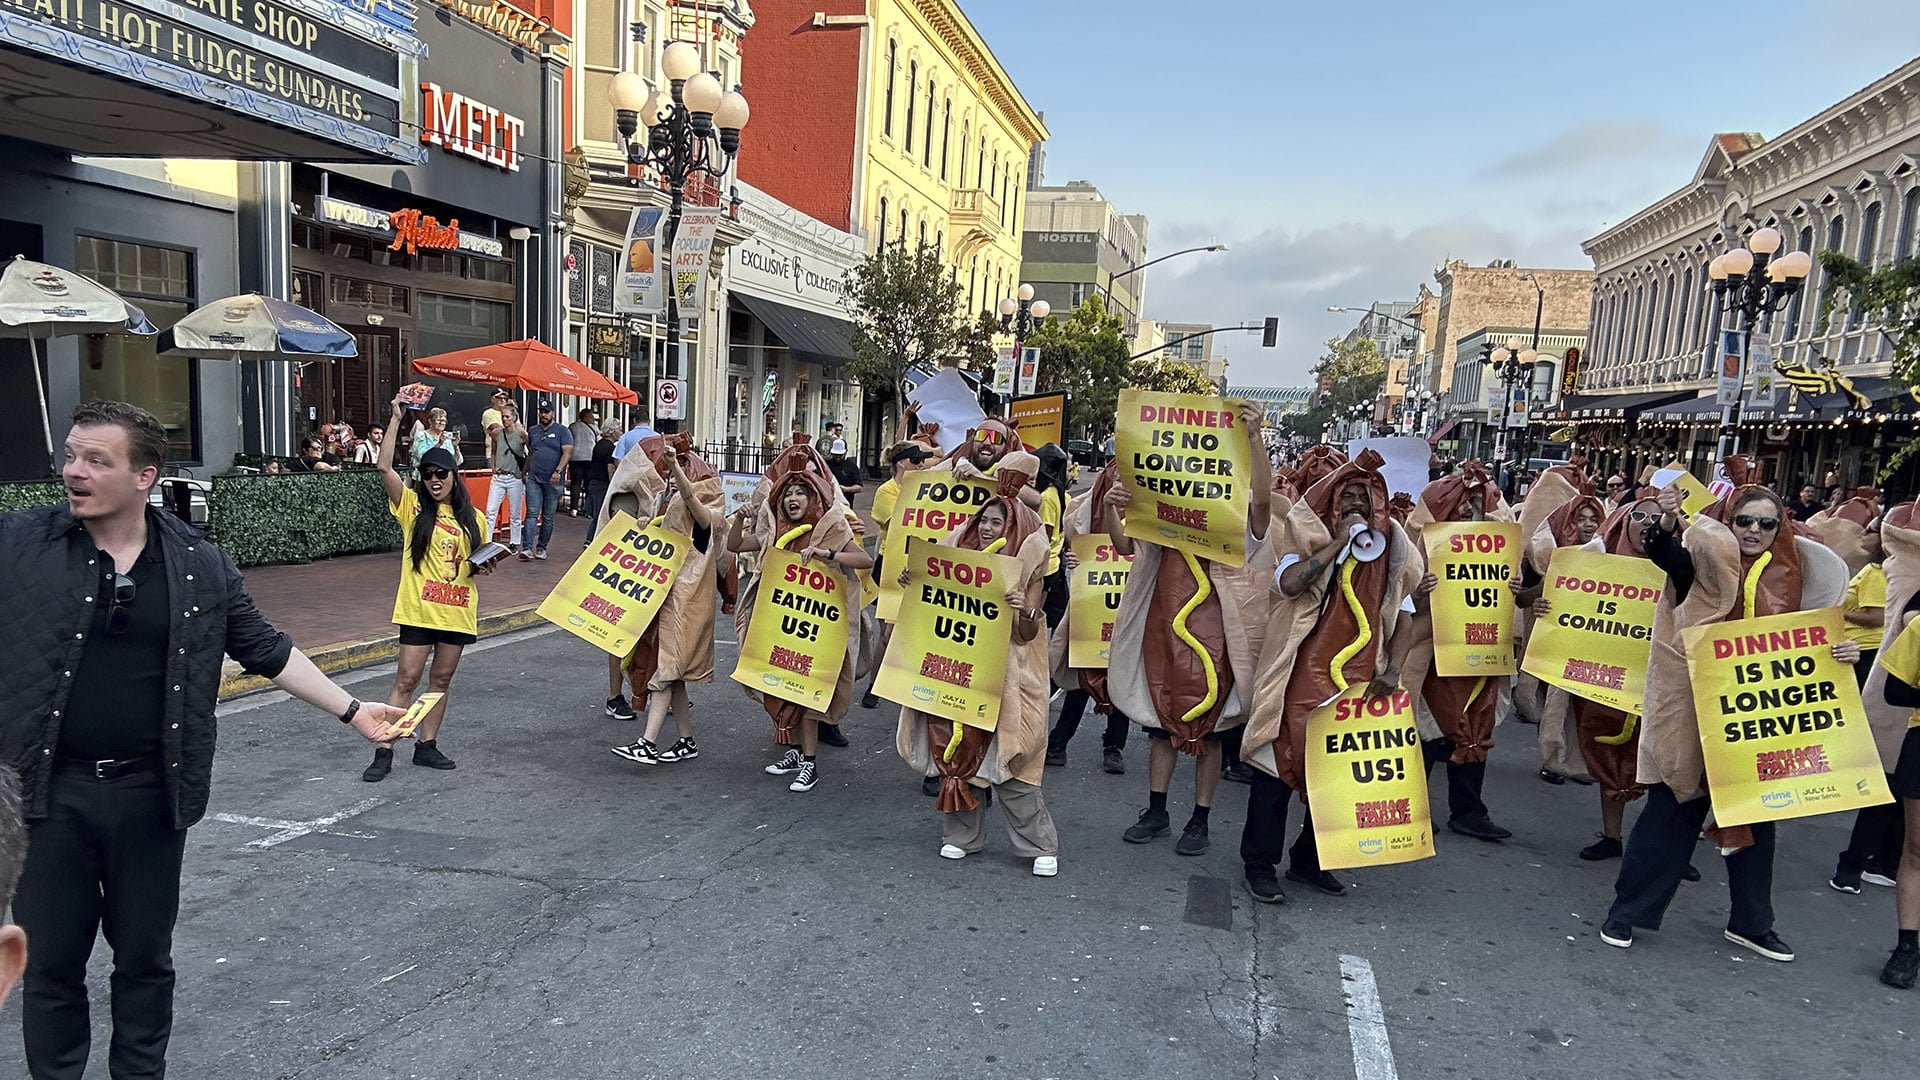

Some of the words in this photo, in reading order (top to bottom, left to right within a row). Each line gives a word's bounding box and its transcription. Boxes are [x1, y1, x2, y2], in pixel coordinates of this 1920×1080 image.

[186, 0, 244, 24] TE
[253, 2, 318, 50] SHOP
[3, 0, 84, 30] AT!
[100, 3, 161, 54] HOT
[172, 27, 257, 88] FUDGE
[264, 62, 363, 121] SUNDAES
[421, 82, 524, 172] MELT
[322, 199, 391, 232] WORLD'S
[459, 232, 503, 257] BURGER
[681, 215, 717, 224] CELEBRATING
[689, 226, 703, 236] THE
[675, 238, 710, 251] POPULAR
[1038, 233, 1091, 243] HOSTEL
[676, 253, 703, 266] ARTS
[741, 249, 789, 279] EXCLUSIVE
[684, 272, 698, 283] CON
[1140, 405, 1234, 428] DINNER
[1152, 430, 1175, 447] IS
[1181, 432, 1219, 451] NO
[1133, 453, 1233, 476] LONGER
[917, 483, 991, 506] FOOD
[1135, 475, 1232, 500] SERVED!
[902, 508, 973, 531] FIGH
[621, 529, 675, 560] FOOD
[1095, 545, 1134, 562] ST
[1450, 534, 1506, 553] STOP
[599, 542, 671, 585] FIGHTS
[927, 556, 992, 588] STOP
[1445, 564, 1510, 581] EATING
[589, 563, 655, 604] BACK!
[784, 564, 836, 594] STOP
[1088, 571, 1129, 585] EATI
[1555, 576, 1661, 603] FOODTOPI
[771, 588, 840, 622] EATING
[921, 584, 999, 620] EATING
[1105, 593, 1121, 609] U
[1465, 588, 1498, 608] US!
[1597, 600, 1617, 615] IS
[781, 615, 819, 642] US!
[934, 616, 977, 646] US!
[1558, 613, 1653, 641] COMING!
[1713, 626, 1829, 659] DINNER
[1735, 662, 1763, 684] IS
[1770, 656, 1816, 679] NO
[913, 685, 935, 697] prime
[942, 694, 959, 702] JULY
[1720, 681, 1838, 715] LONGER
[1335, 691, 1411, 721] STOP
[1725, 708, 1845, 742] SERVED!
[1326, 726, 1417, 754] EATING
[1351, 757, 1405, 783] US!
[1761, 790, 1792, 803] prime
[1803, 787, 1826, 795] JULY
[1822, 793, 1842, 801] Series
[1358, 838, 1382, 848] prime
[1390, 836, 1405, 844] JULY
